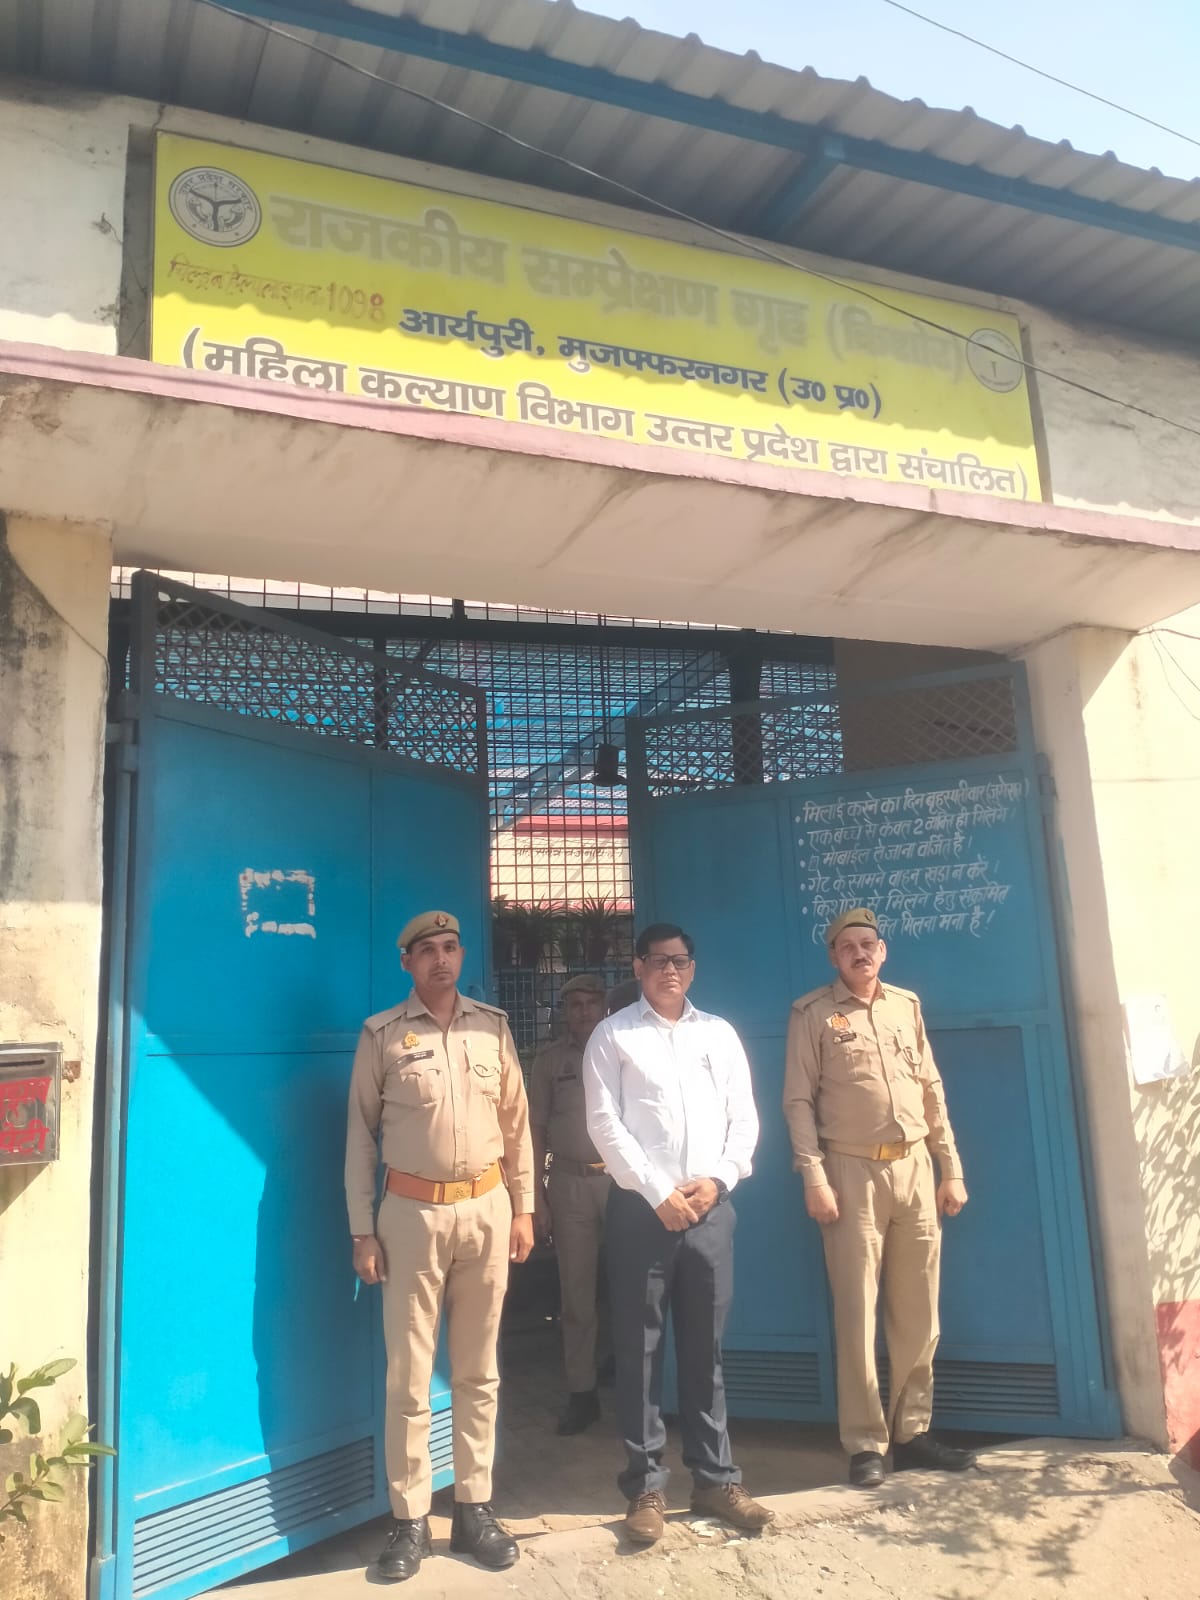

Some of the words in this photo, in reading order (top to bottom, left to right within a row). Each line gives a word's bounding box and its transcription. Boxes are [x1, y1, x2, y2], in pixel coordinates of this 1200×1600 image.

[268, 194, 508, 288] राजकीय
[729, 288, 809, 354] गृह
[399, 308, 545, 358] आर्यपुरी,
[557, 336, 769, 393] मुजफ्फरनगर
[183, 327, 348, 393] (महिला
[358, 367, 506, 416] कल्याण
[516, 382, 635, 437] विभाग
[645, 413, 735, 452] उत्तर
[741, 423, 819, 465] प्रदेश
[827, 442, 889, 474] द्वारा
[896, 448, 1028, 501] संचालित)
[803, 797, 846, 826] मिलाई
[880, 796, 902, 813] का
[903, 787, 926, 816] दिन
[807, 829, 833, 852] एक
[862, 818, 879, 838] से
[879, 816, 912, 842] केवल
[913, 818, 924, 835] 2
[953, 806, 970, 833] ही
[917, 833, 952, 860] वर्जित
[808, 869, 831, 893] गेट
[832, 867, 847, 890] के
[847, 864, 888, 896] सामने
[889, 868, 922, 893] वाहन
[866, 889, 885, 911] से
[886, 887, 933, 912] मिलने
[933, 885, 960, 912] हेतु
[901, 911, 938, 940] मिलना
[939, 913, 970, 931] मना
